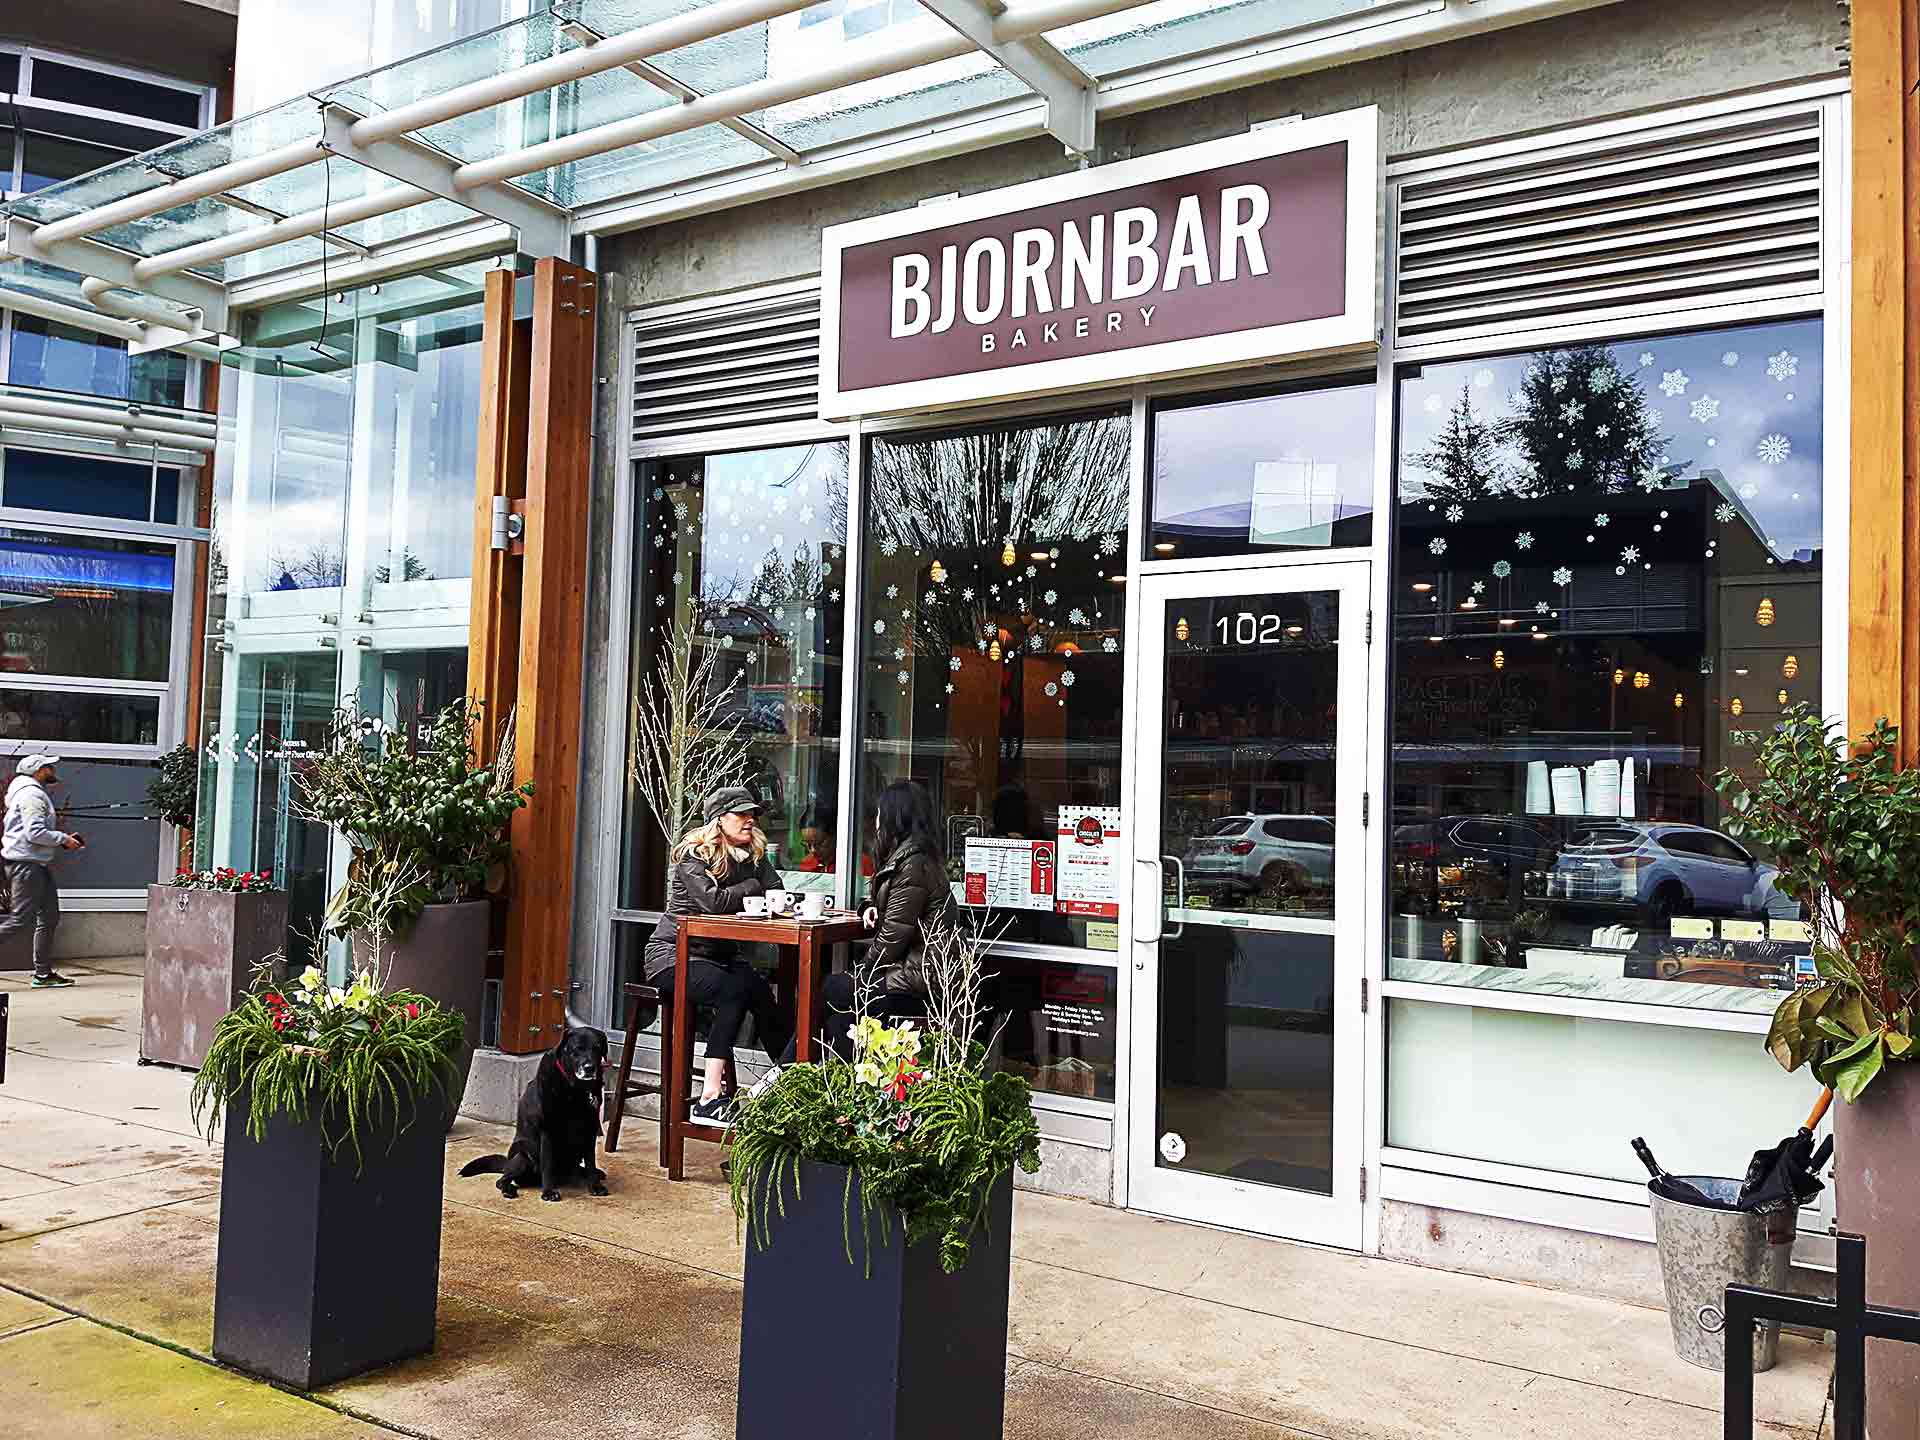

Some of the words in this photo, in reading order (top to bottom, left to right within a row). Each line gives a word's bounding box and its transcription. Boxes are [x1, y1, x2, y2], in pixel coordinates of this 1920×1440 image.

[890, 183, 1271, 338] BJORNBAR
[981, 305, 1156, 354] BAKERY
[1216, 613, 1281, 645] 102
